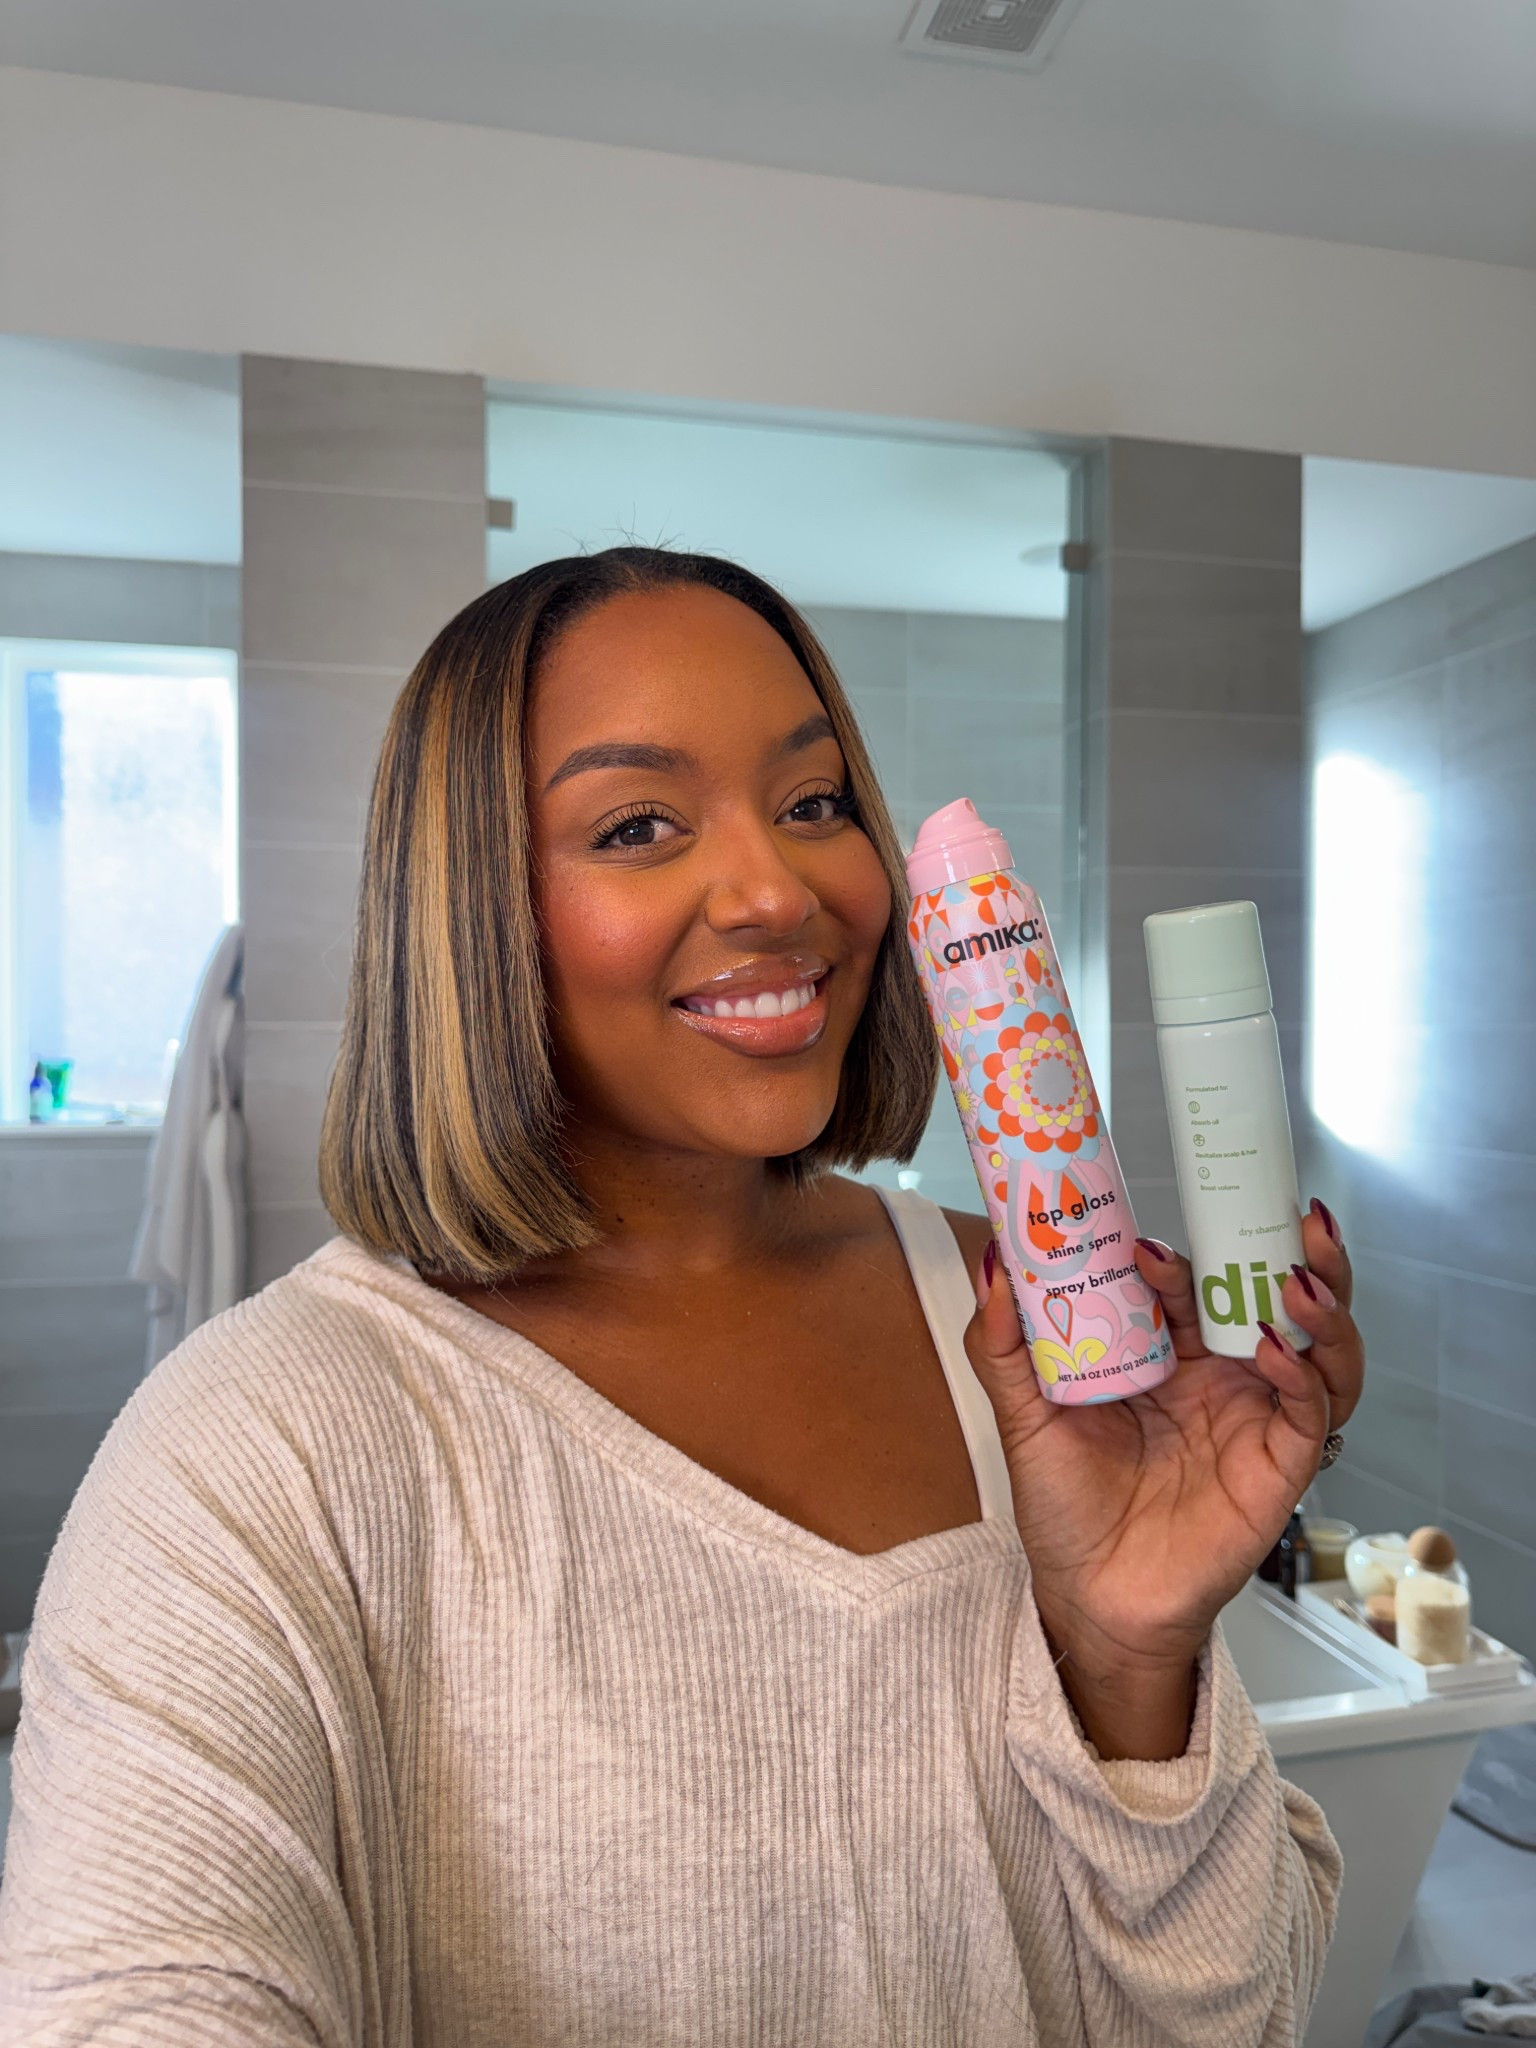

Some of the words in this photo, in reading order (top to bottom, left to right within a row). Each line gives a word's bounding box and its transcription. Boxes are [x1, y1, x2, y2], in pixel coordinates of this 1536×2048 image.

[1186, 1085, 1219, 1093] Formulated
[1195, 1151, 1223, 1159] Revitalize
[1223, 1150, 1240, 1158] scalp
[1028, 1208, 1064, 1227] top
[1070, 1190, 1116, 1221] gloss
[1238, 1227, 1253, 1237] dry
[1255, 1221, 1290, 1235] shampoo
[1046, 1243, 1085, 1260] shine
[1088, 1230, 1122, 1251] spray
[1045, 1281, 1086, 1298] spray
[1058, 1374, 1073, 1383] NET
[1074, 1372, 1087, 1382] 4.8
[1087, 1369, 1102, 1380] OZ
[1103, 1364, 1122, 1378] (135
[1123, 1361, 1134, 1373] G)
[1134, 1355, 1149, 1368] 200
[1149, 1351, 1159, 1361] ML
